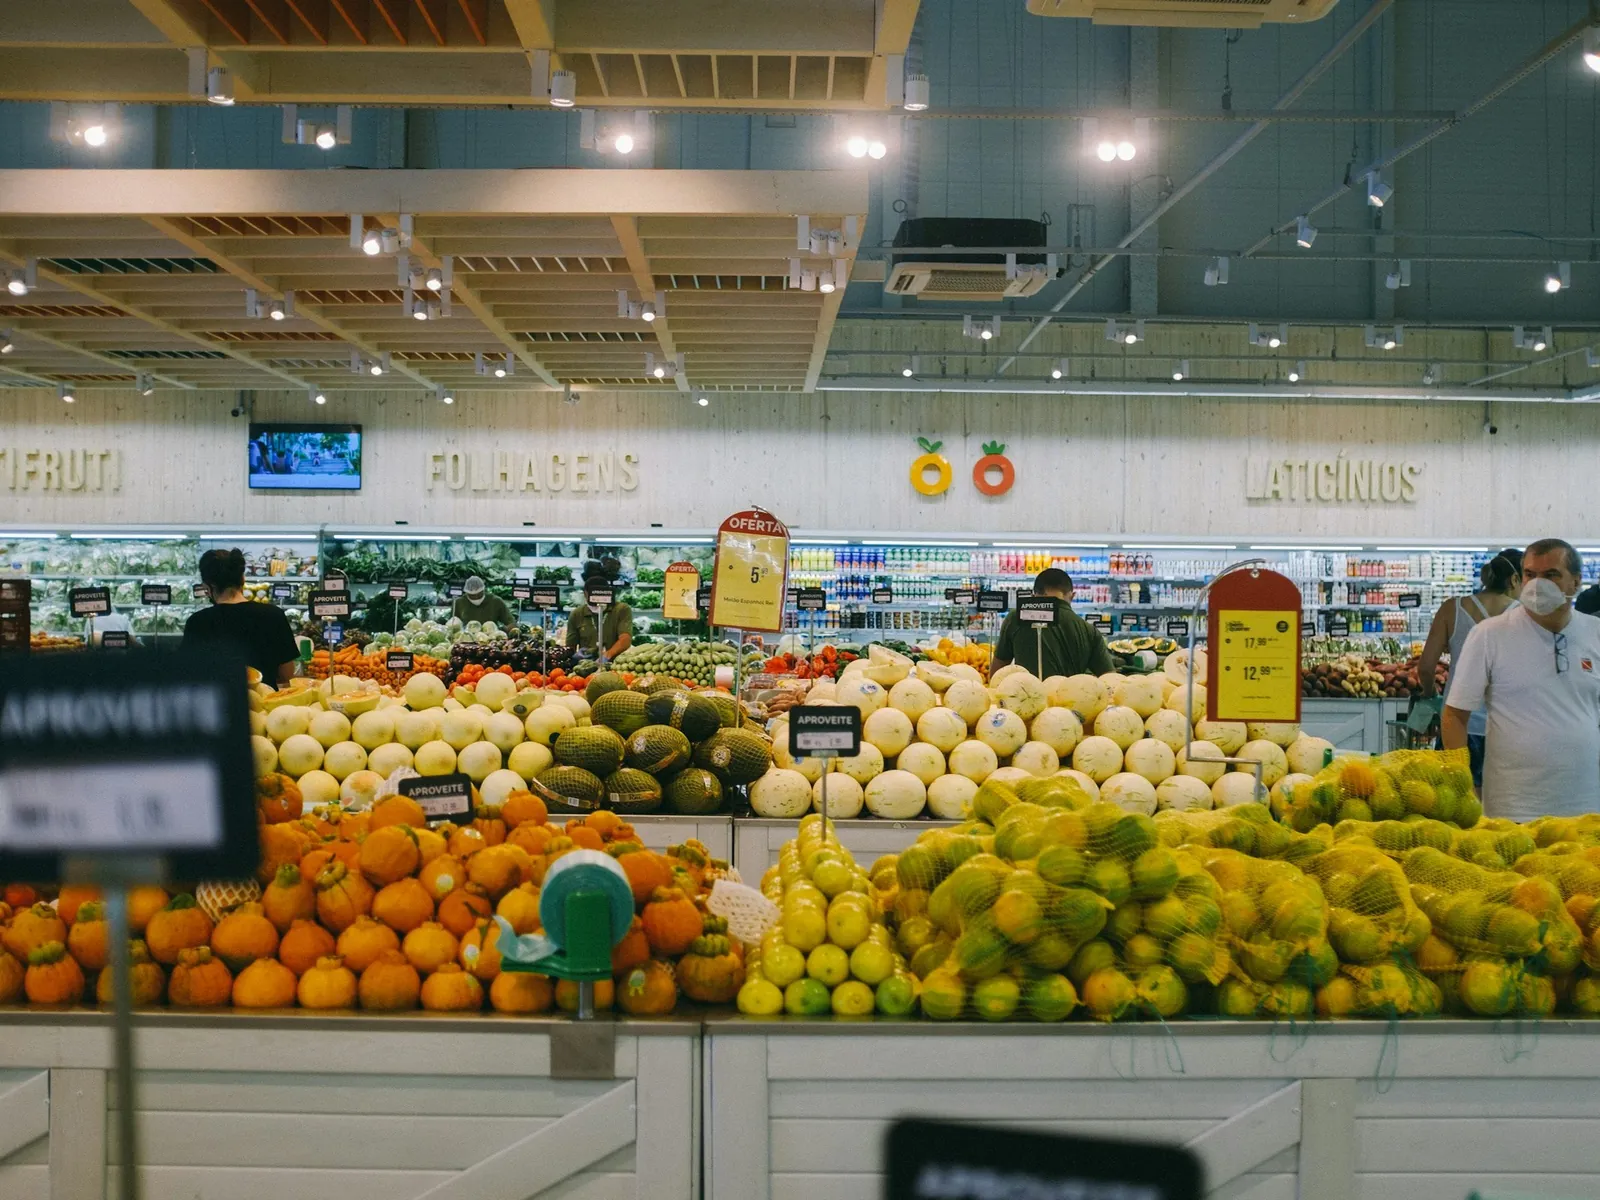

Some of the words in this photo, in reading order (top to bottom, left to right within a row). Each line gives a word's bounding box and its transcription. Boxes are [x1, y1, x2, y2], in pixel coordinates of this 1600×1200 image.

[0, 448, 121, 490] IFRUTI
[425, 450, 639, 492] FOLHAGENS
[1246, 450, 1420, 503] LATICÍNIOS
[729, 518, 782, 533] OFERTA
[1243, 665, 1271, 682] 12,99
[797, 715, 853, 725] APROVEITE
[408, 783, 464, 797] APROVEITE
